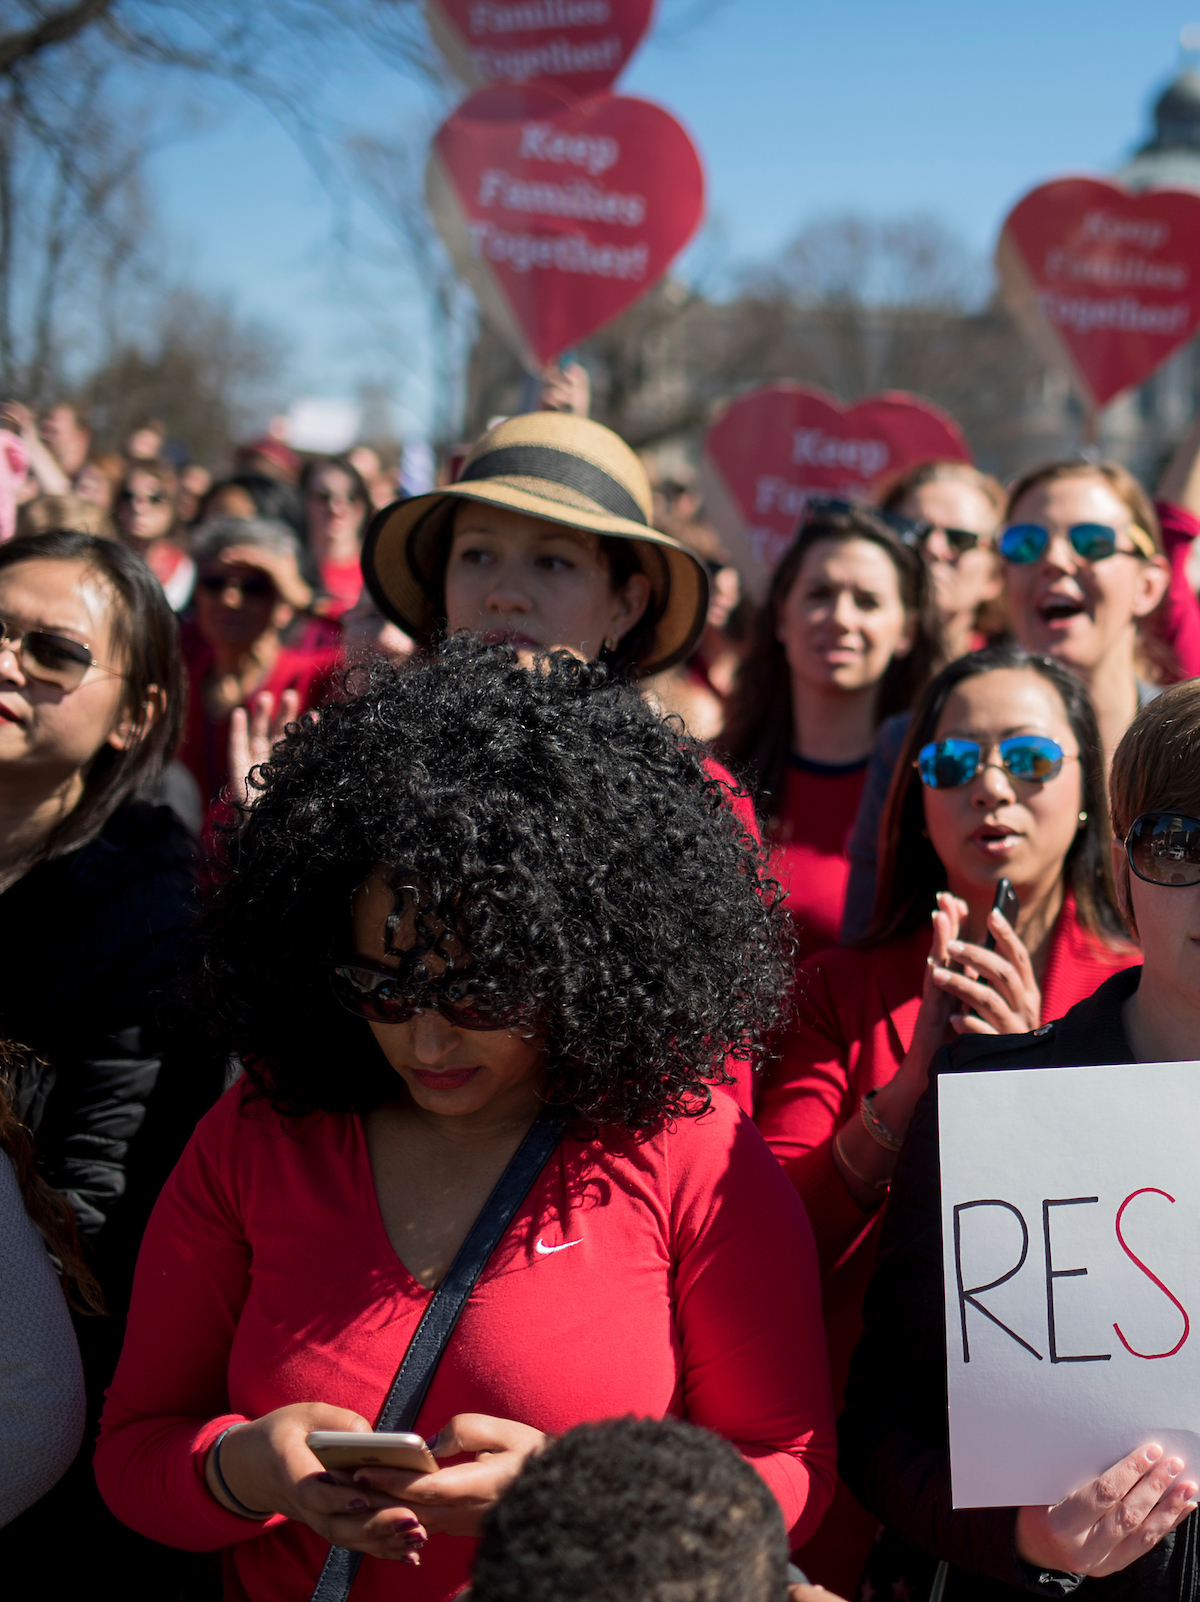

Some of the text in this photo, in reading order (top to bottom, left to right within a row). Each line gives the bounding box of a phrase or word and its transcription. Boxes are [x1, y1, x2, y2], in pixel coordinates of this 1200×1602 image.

[519, 121, 619, 173] Keep
[477, 169, 645, 226] Families
[467, 221, 648, 280] Together!
[790, 427, 889, 477] Keep
